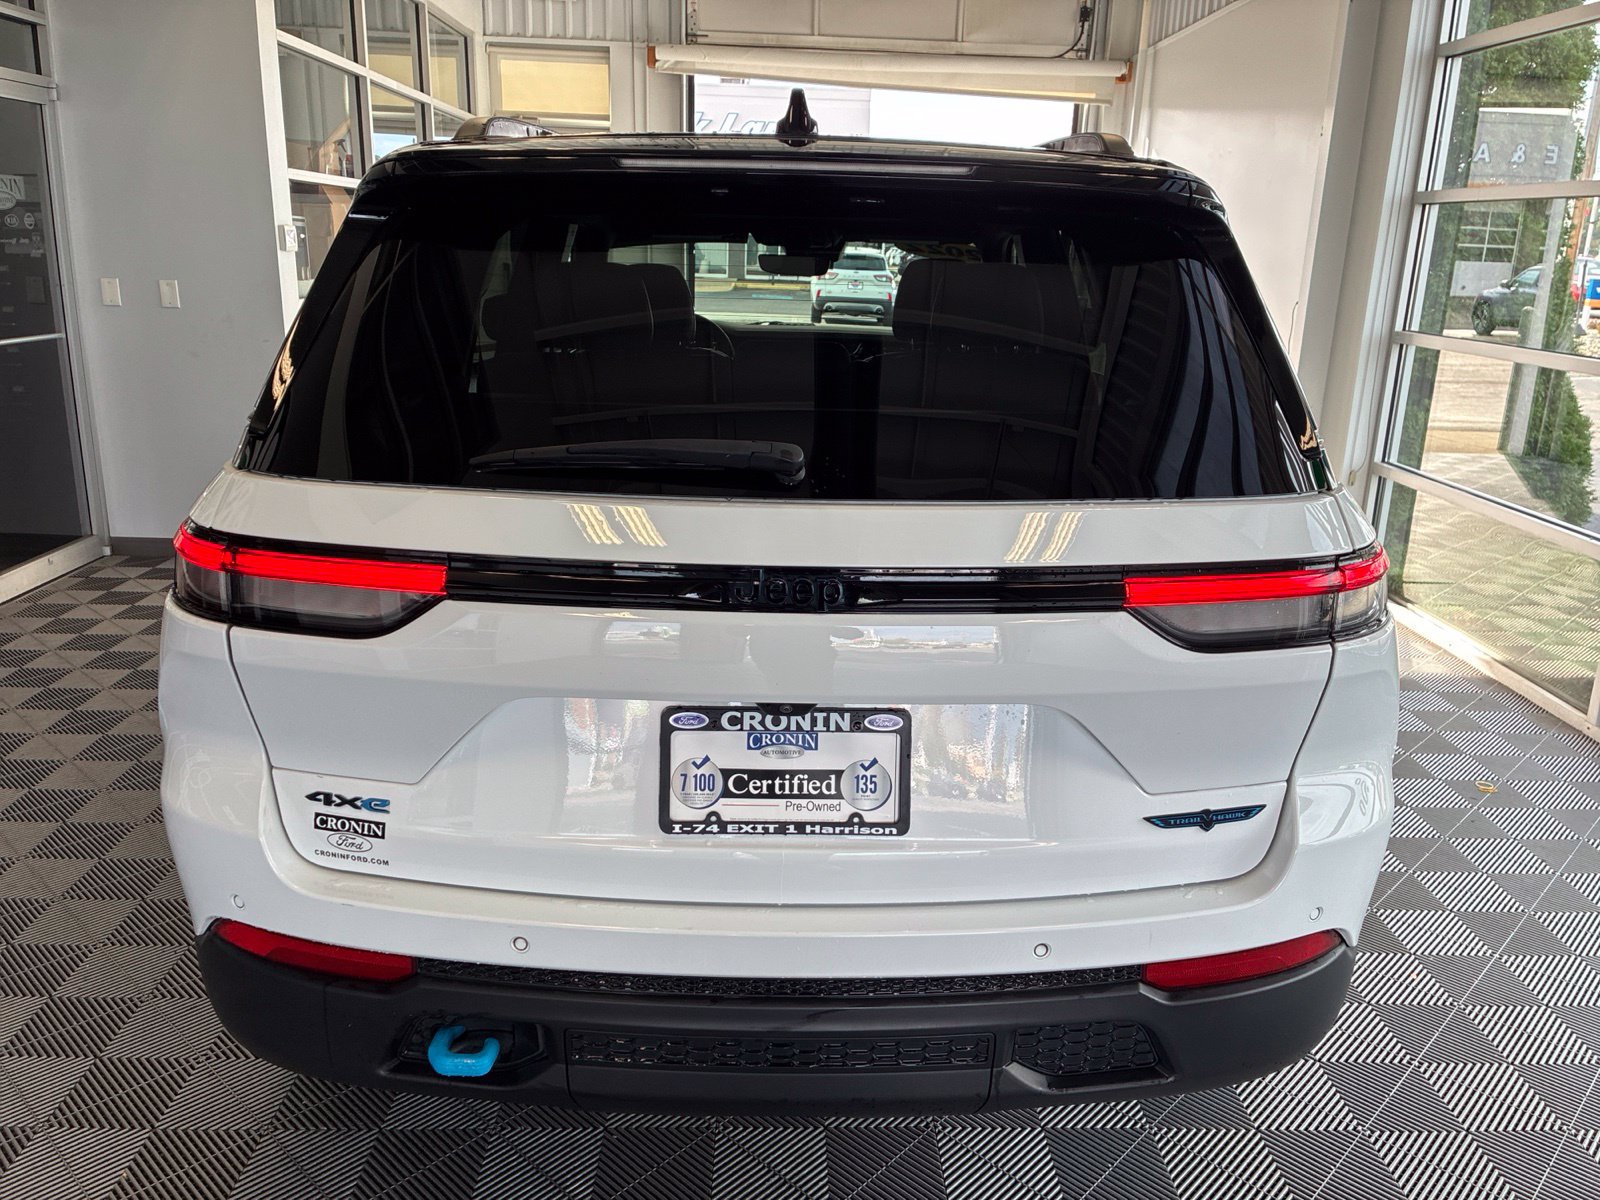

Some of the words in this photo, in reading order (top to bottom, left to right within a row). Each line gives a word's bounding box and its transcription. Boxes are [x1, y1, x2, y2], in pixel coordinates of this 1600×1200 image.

[732, 568, 844, 612] Jeep
[676, 714, 701, 725] Ford
[720, 711, 850, 732] CRONIN
[873, 717, 896, 728] Ford
[749, 732, 816, 749] CRONIN
[680, 774, 688, 792] 7
[692, 773, 716, 792] 100
[727, 773, 837, 795] Certified
[854, 774, 878, 794] 135
[785, 801, 841, 812] Pre-Owned
[316, 815, 384, 837] CRONIN
[672, 824, 720, 833] I-74
[727, 824, 779, 833] EXIT
[785, 824, 798, 833] 1
[805, 824, 898, 835] Harrison
[335, 834, 364, 850] Ford
[314, 849, 390, 866] CRONINFORD.COM
